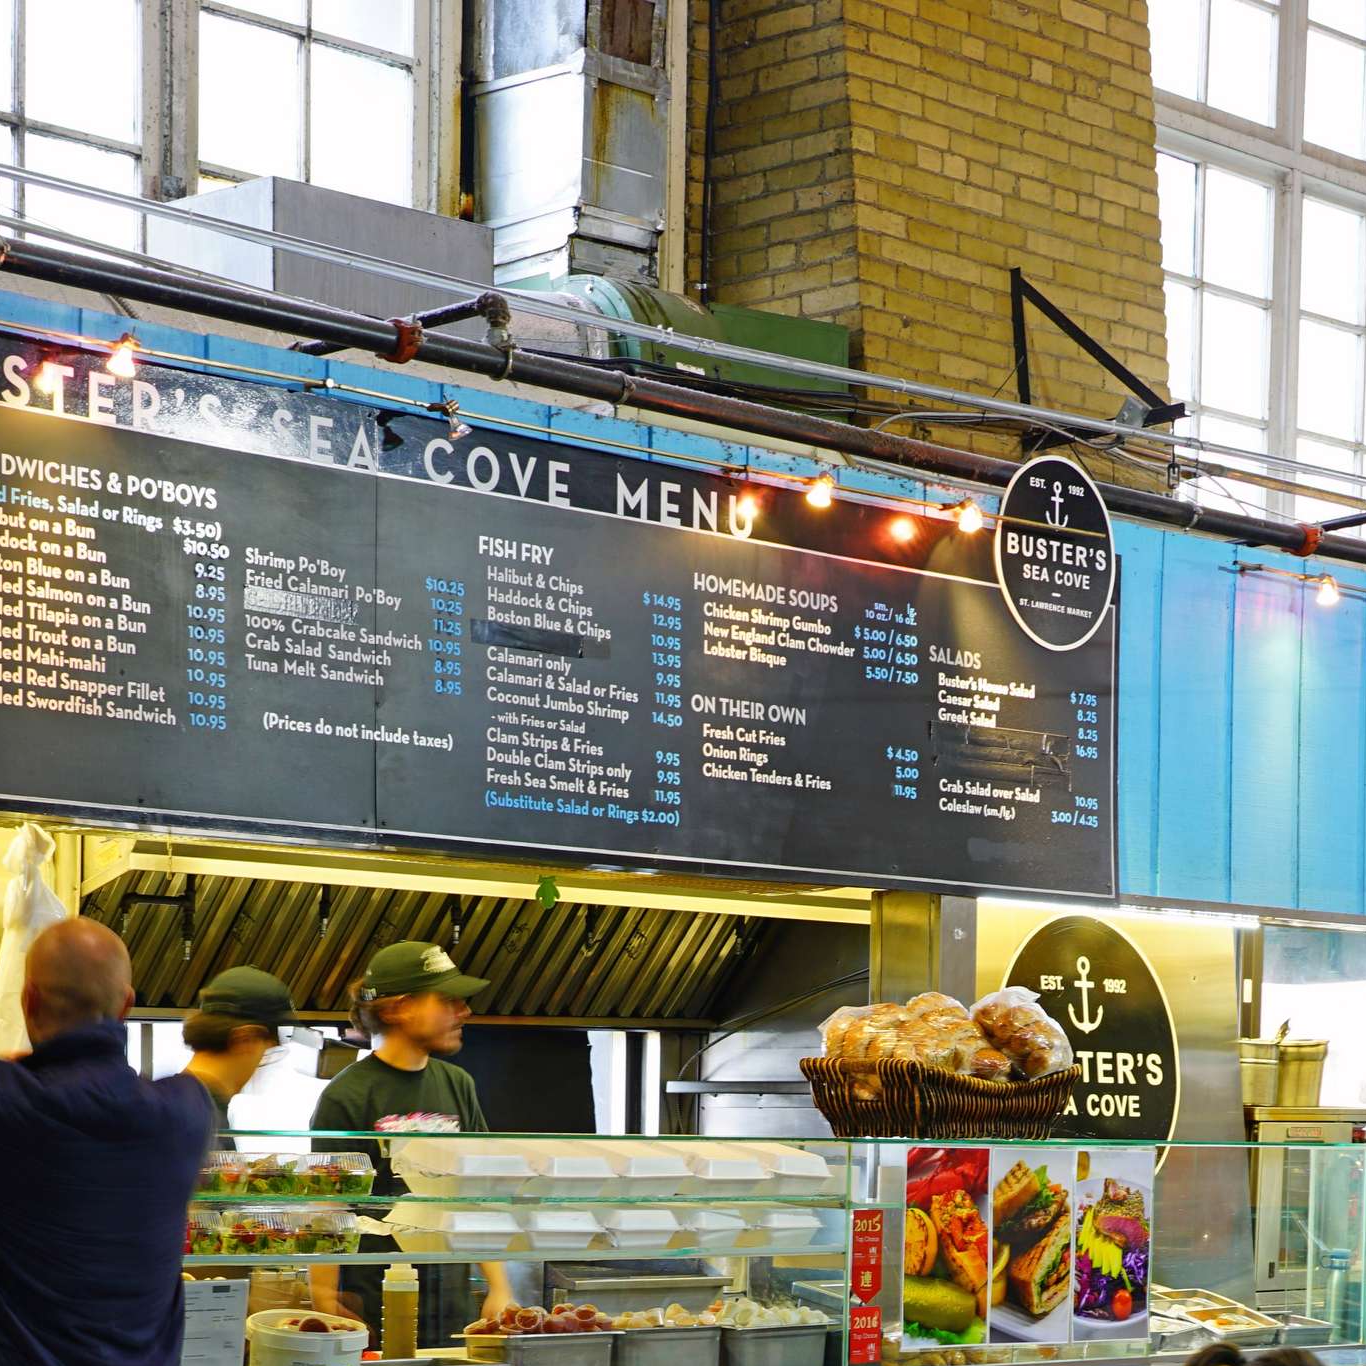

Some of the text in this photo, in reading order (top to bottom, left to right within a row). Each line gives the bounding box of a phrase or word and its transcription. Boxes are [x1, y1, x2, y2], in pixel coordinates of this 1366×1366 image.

[423, 438, 570, 506] COVE
[1030, 477, 1085, 497] EST. 1992
[106, 472, 122, 494] &
[127, 475, 217, 509] PO'BOYS
[479, 535, 554, 565] FISH FRY
[1007, 532, 1107, 571] BUSTER'S
[693, 572, 838, 613] HOMEMADE SOUPS
[1023, 564, 1090, 590] SEA COVE
[26, 579, 83, 604] Salmon
[86, 593, 105, 607] on
[110, 597, 119, 609] a
[122, 594, 151, 614] Bun
[187, 605, 225, 624] 10.95
[1031, 600, 1065, 614] LAWRENCE
[1067, 605, 1092, 618] MARKET
[704, 640, 787, 668] Lobster Bisque
[929, 645, 981, 669] SALADS
[245, 653, 462, 695] Tuna Melt Sandwich 8.95
[691, 694, 806, 726] ON THEIR OWN
[938, 707, 1098, 742] Greek Salad 8.25
[263, 712, 453, 751] (Prices do not include taxes)
[702, 742, 919, 780] Onion Rings 5.00
[1040, 975, 1127, 994] EST. 1992
[1086, 1093, 1141, 1117] COVE
[854, 1213, 881, 1232] 2015
